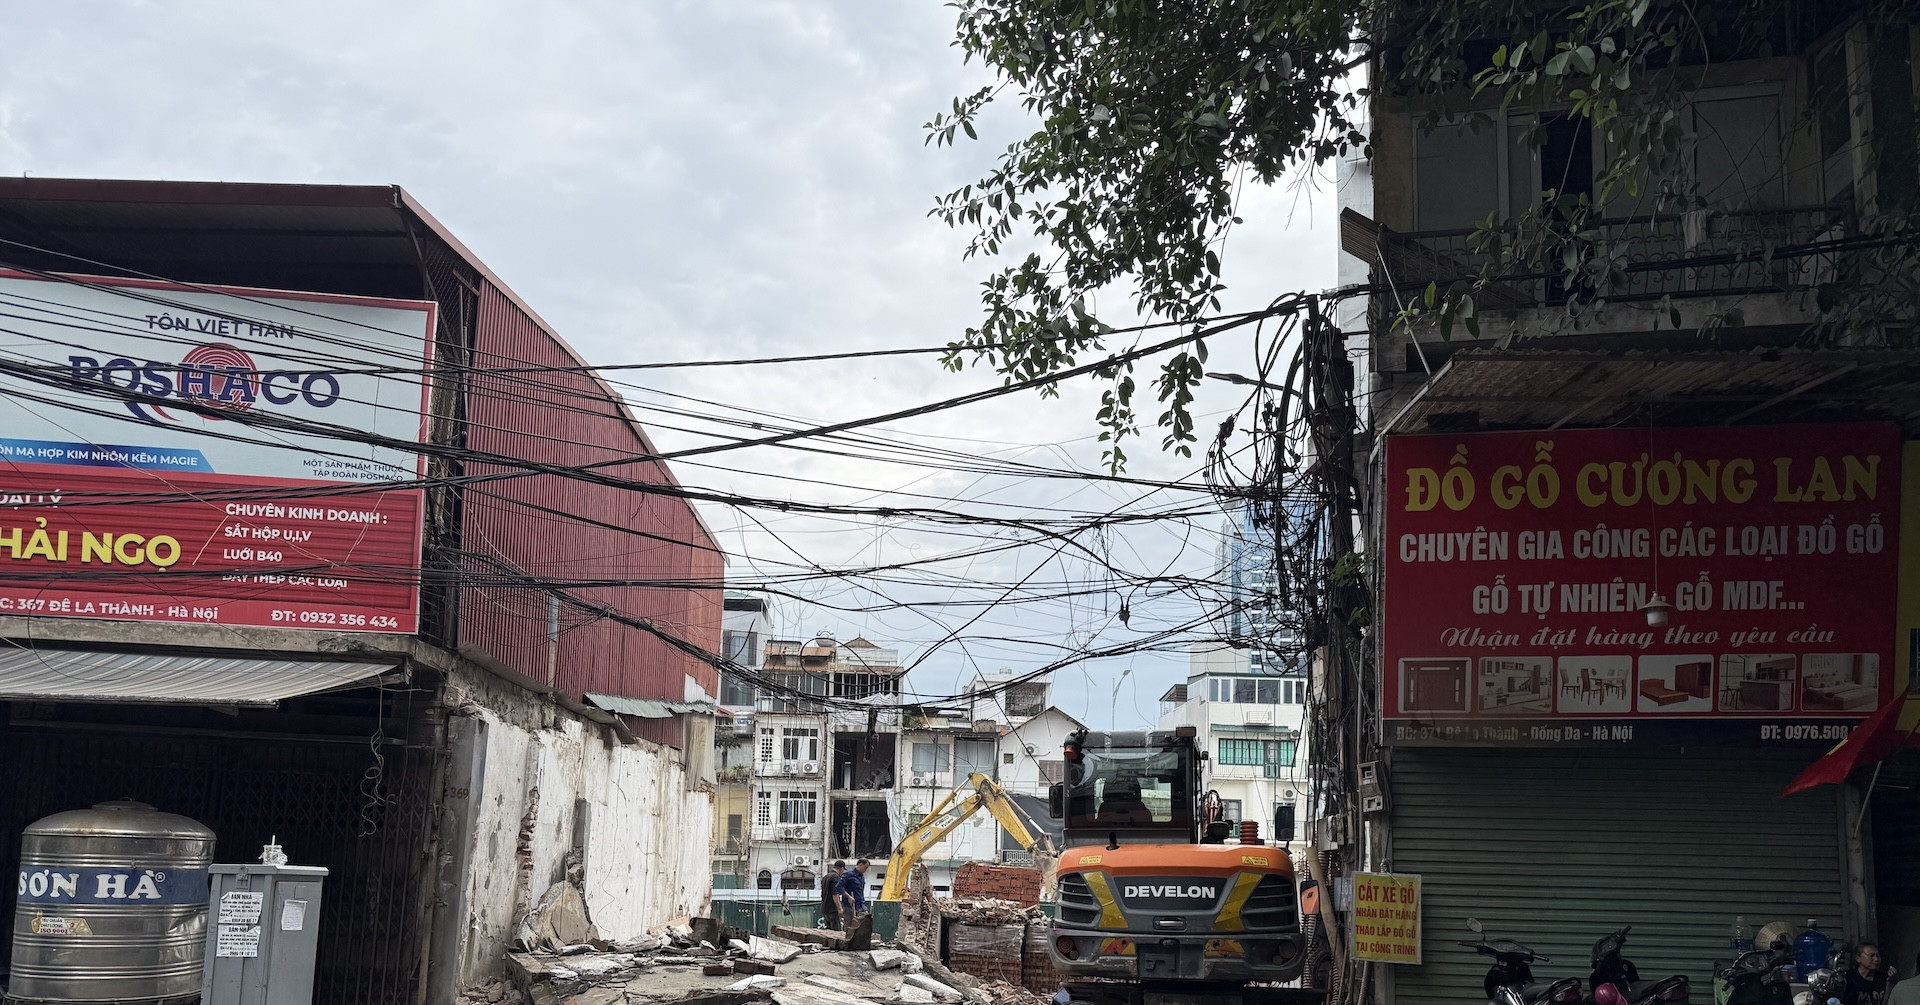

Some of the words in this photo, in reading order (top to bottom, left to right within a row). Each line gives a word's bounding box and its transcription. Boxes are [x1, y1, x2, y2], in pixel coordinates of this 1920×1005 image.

[145, 313, 190, 331] TÔN
[196, 315, 245, 337] VIỆT
[248, 319, 294, 339] HÀN
[68, 354, 340, 408] POSHACO
[16, 446, 35, 459] MẠ
[38, 448, 64, 460] HỢP
[67, 450, 89, 460] KIM
[92, 450, 129, 462] NHÔM
[132, 450, 157, 463] KẼM
[160, 456, 198, 466] MAGIE
[303, 459, 323, 468] MỘT
[313, 469, 330, 478] TẬP
[332, 470, 358, 479] ĐOÀN
[1405, 443, 1476, 512] ĐỒ
[1490, 440, 1560, 511] GỖ
[1575, 452, 1758, 508] CƯƠNG
[1774, 454, 1881, 502] LAN
[225, 503, 284, 518] CHUYÊN
[288, 507, 323, 520] KINH
[327, 510, 380, 523] DOANH
[224, 523, 250, 538] SẮT
[252, 526, 281, 541] HỘP
[283, 530, 312, 543] U,I,V
[1400, 525, 1509, 562] CHUYÊN
[1517, 529, 1564, 560] GIA
[1573, 523, 1650, 560] CÔNG
[1659, 520, 1716, 558] CÁC
[1726, 524, 1789, 563] LOẠI
[1797, 514, 1837, 556] ĐỒ
[1846, 513, 1885, 554] GỖ
[0, 516, 69, 562] HẢI
[81, 531, 181, 572] NGỌ
[257, 550, 283, 562] B40
[317, 577, 347, 590] LOẠI
[1472, 575, 1509, 615] GỖ
[1518, 580, 1554, 619] TỰ
[1560, 577, 1647, 612] NHIÊN
[1675, 571, 1713, 611] GỖ
[1722, 580, 1805, 610] MDF...
[17, 599, 45, 611] 367
[48, 598, 71, 612] ĐÊ
[75, 602, 96, 614] LA
[99, 601, 154, 616] THÀNH
[168, 606, 188, 618] Hà
[193, 607, 219, 622] Nội
[271, 610, 296, 622] ĐT:
[300, 611, 336, 624] 0932
[339, 613, 366, 626] 356
[369, 615, 398, 628] 434
[1440, 626, 1521, 650] Nhận
[1530, 625, 1577, 649] đặt
[1586, 625, 1655, 649] hàng
[1664, 625, 1719, 646] theo
[1730, 626, 1777, 648] yêu
[1787, 622, 1836, 643] cầu
[1530, 723, 1561, 742] Đống
[1564, 726, 1581, 740] Đa
[1592, 725, 1609, 740] Hà
[1612, 724, 1633, 743] Nội
[1761, 725, 1781, 740] ĐT:
[1784, 724, 1859, 740] 0976.508
[450, 787, 469, 799] 369
[18, 869, 80, 898] SƠN
[94, 869, 162, 899] HÀ
[1124, 884, 1216, 899] DEVELON
[1358, 880, 1379, 902] CẮT
[1400, 881, 1415, 904] GỖ
[1355, 906, 1377, 920] NHẬN
[1379, 907, 1395, 921] ĐẶT
[1395, 907, 1417, 920] HÀNG
[1356, 941, 1368, 954] TẠI
[1370, 941, 1391, 953] CÔNG
[1393, 943, 1416, 956] TRÌNH
